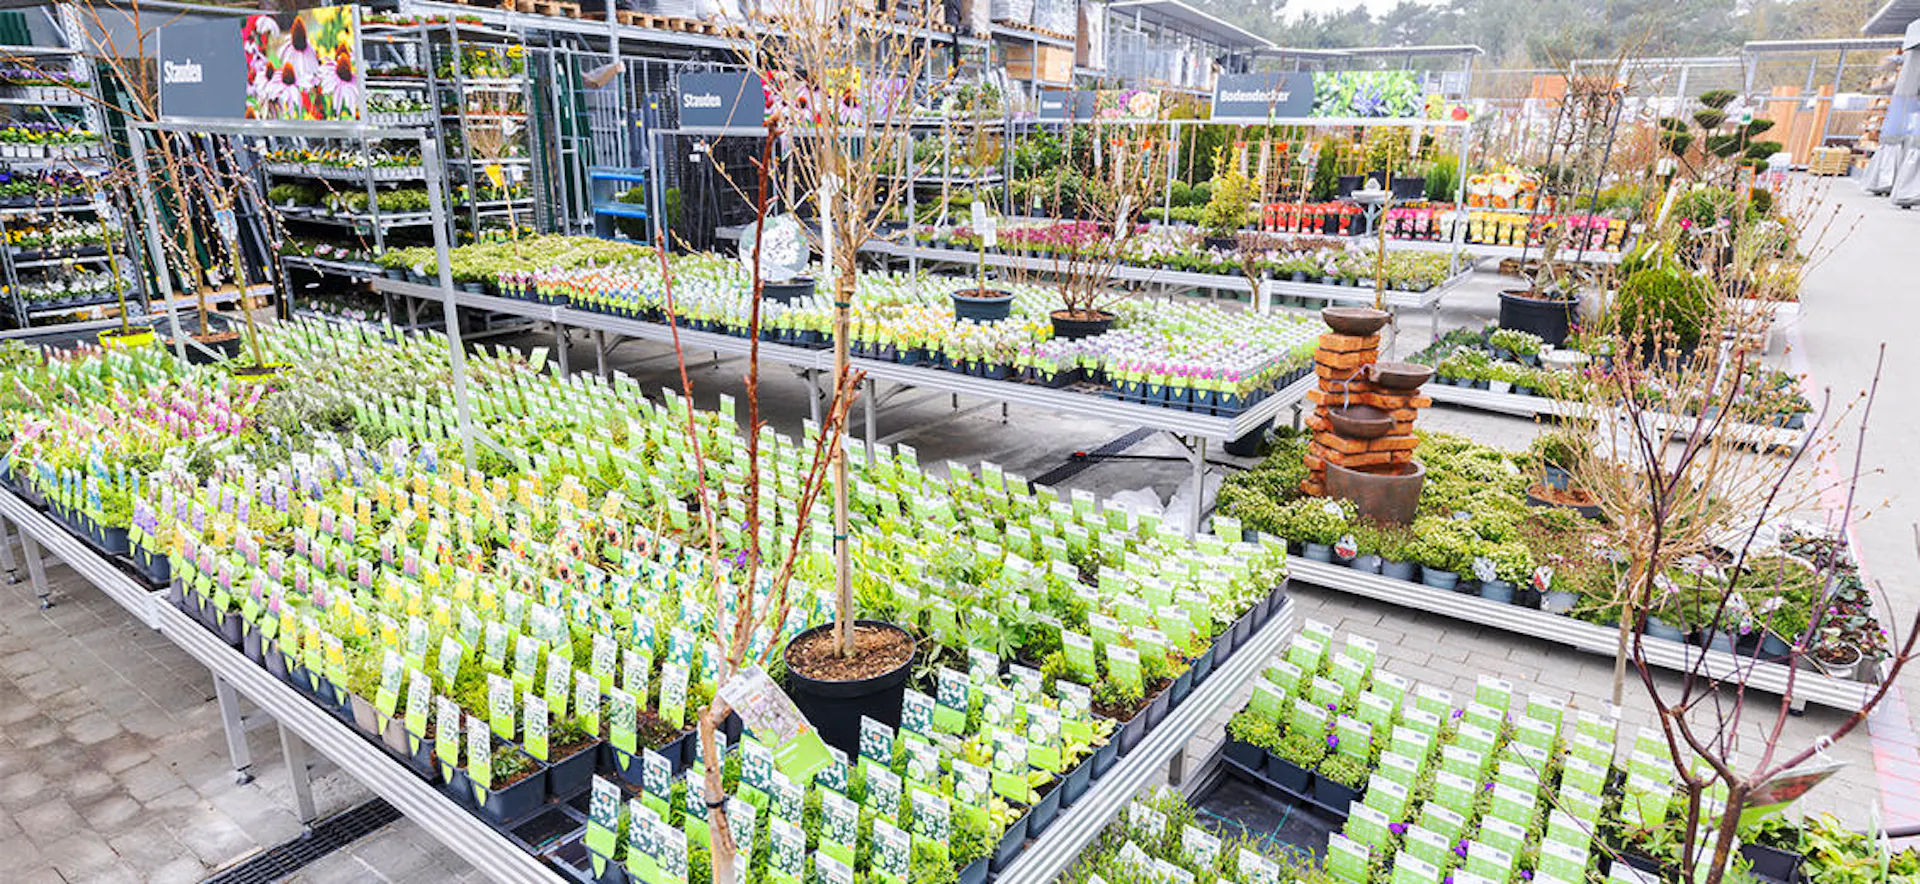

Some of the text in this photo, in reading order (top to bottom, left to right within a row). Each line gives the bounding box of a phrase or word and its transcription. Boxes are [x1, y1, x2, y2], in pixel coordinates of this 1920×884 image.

[164, 58, 203, 83] Stauden
[683, 92, 722, 108] Stauden
[1220, 89, 1289, 102] Bodendecker
